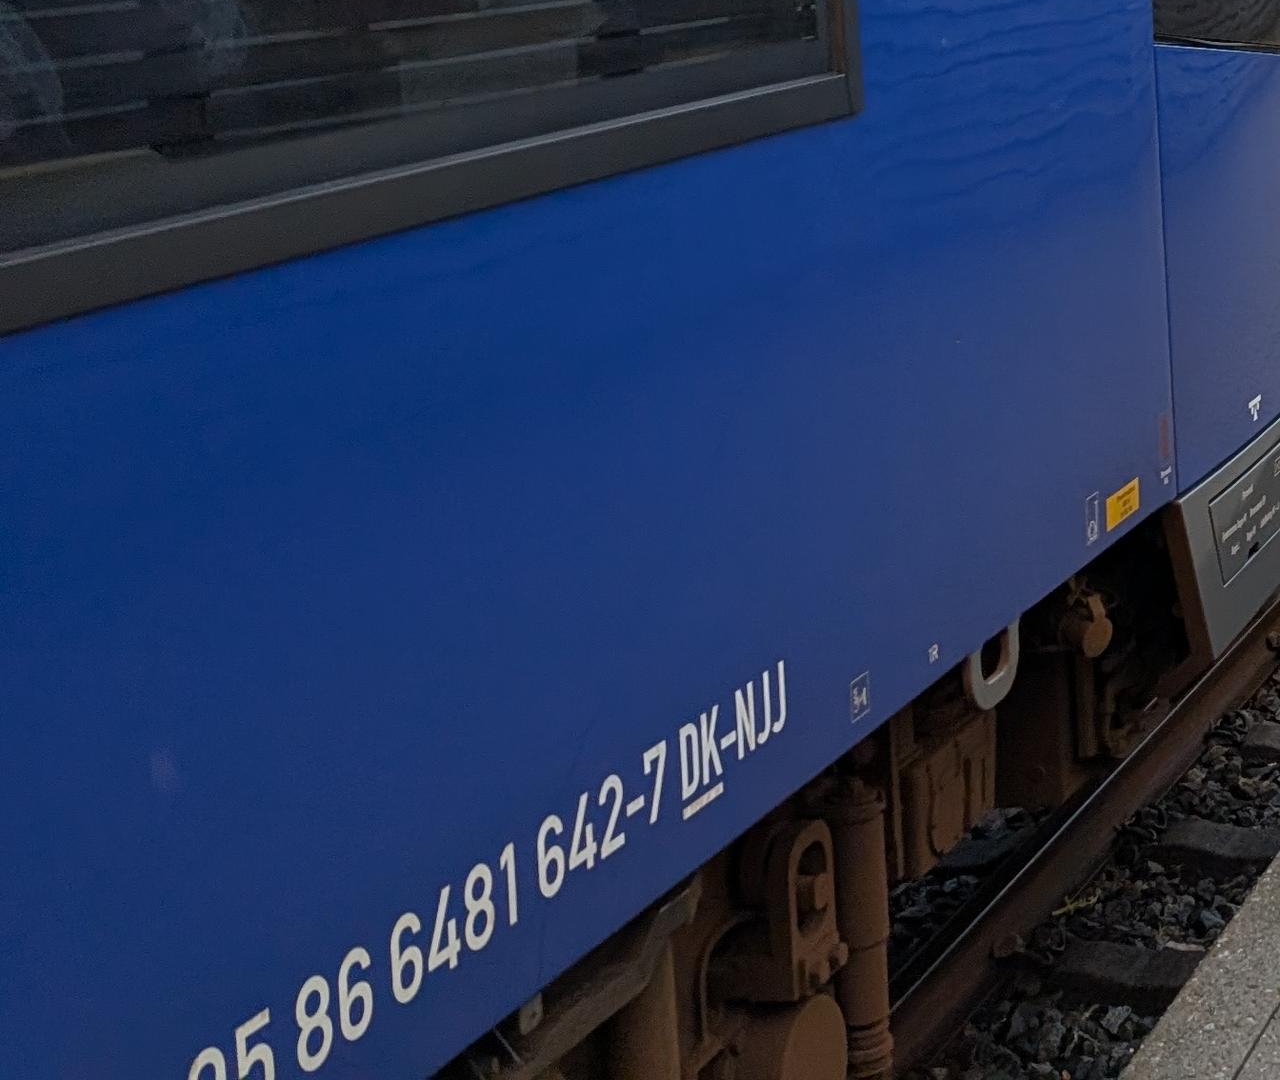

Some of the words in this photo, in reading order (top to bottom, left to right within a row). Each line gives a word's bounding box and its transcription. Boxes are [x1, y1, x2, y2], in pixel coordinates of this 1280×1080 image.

[294, 945, 374, 1073] 86
[389, 841, 520, 1005] 6481
[536, 738, 668, 899] 642-7
[678, 659, 788, 808] DK-NJJ
